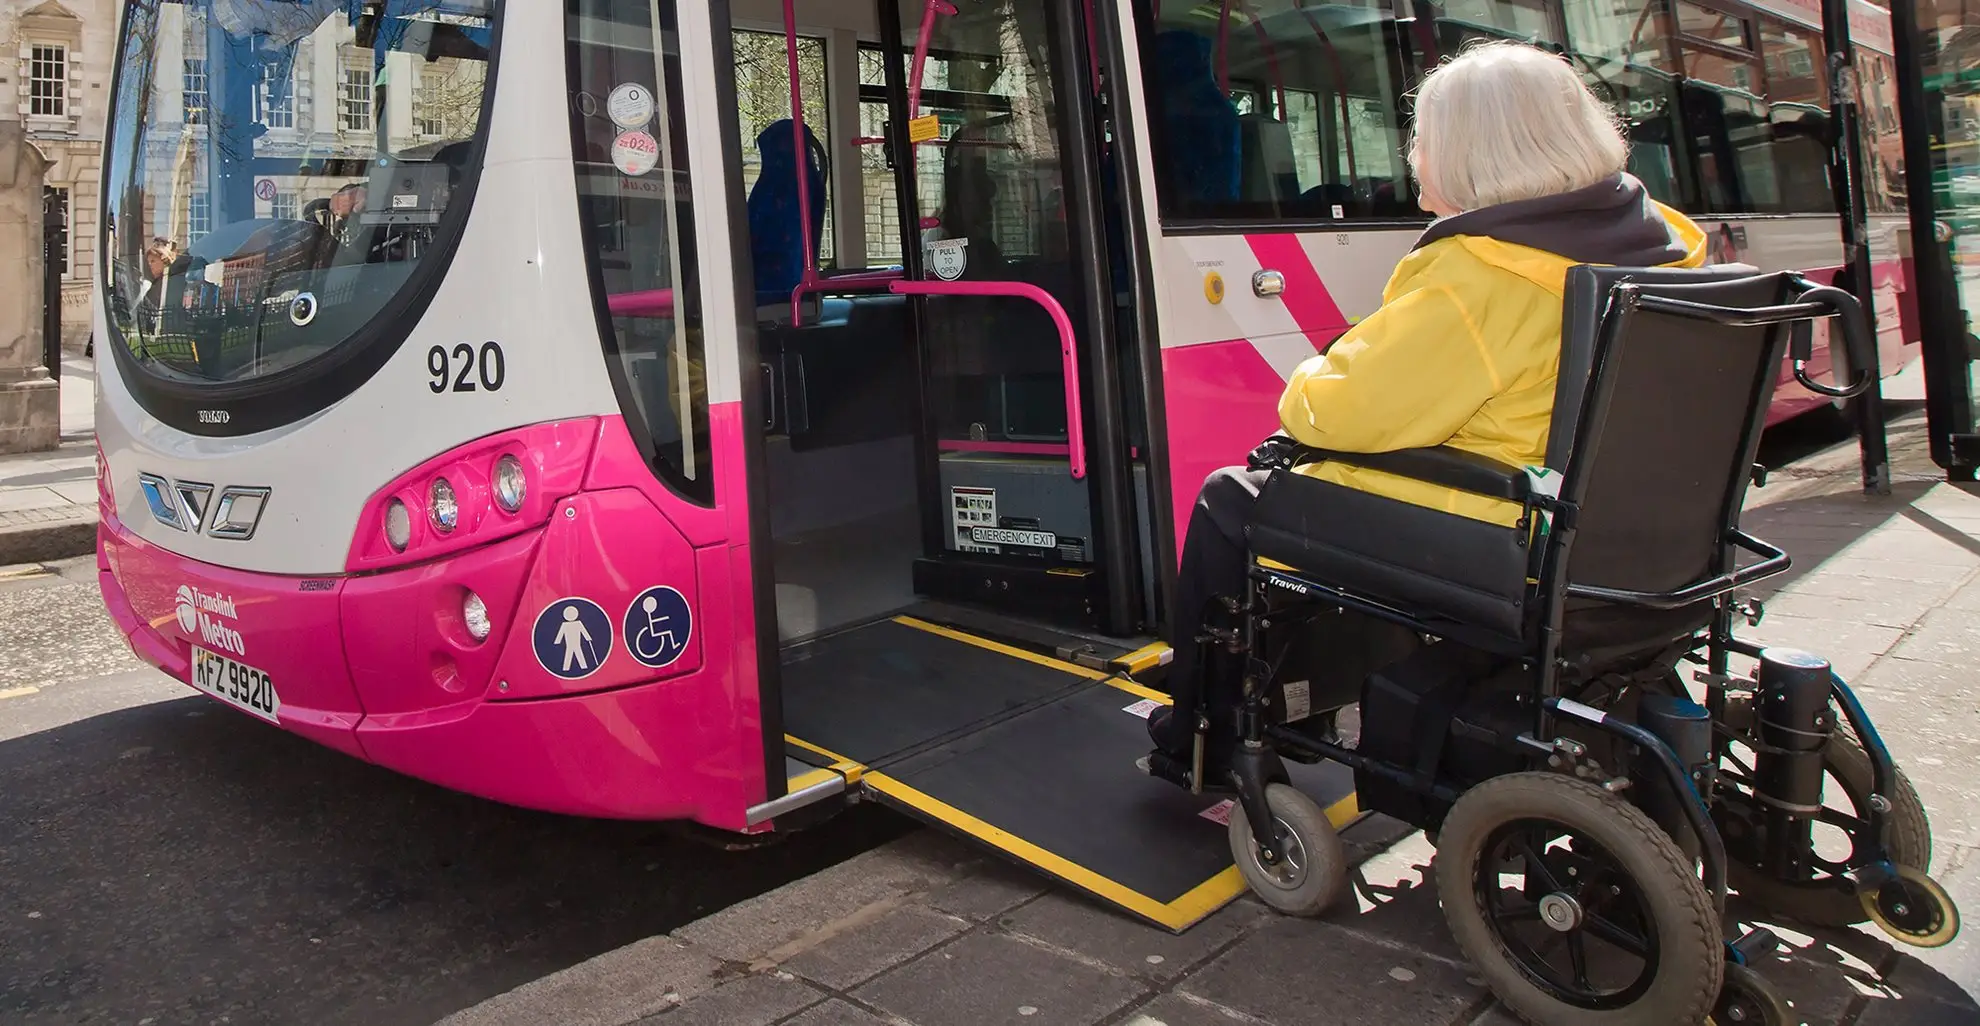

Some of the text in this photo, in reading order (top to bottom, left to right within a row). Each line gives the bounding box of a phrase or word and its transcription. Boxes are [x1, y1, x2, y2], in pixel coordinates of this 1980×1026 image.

[629, 138, 645, 151] 02
[1336, 233, 1350, 246] 920
[940, 266, 959, 275] OPEN
[428, 341, 505, 394] 920
[197, 410, 230, 423] VOLVO
[974, 528, 1054, 546] EMERGENCY EXIT
[192, 586, 238, 620] Translink
[198, 611, 245, 656] Metro
[197, 647, 273, 713] KFZ 9920
